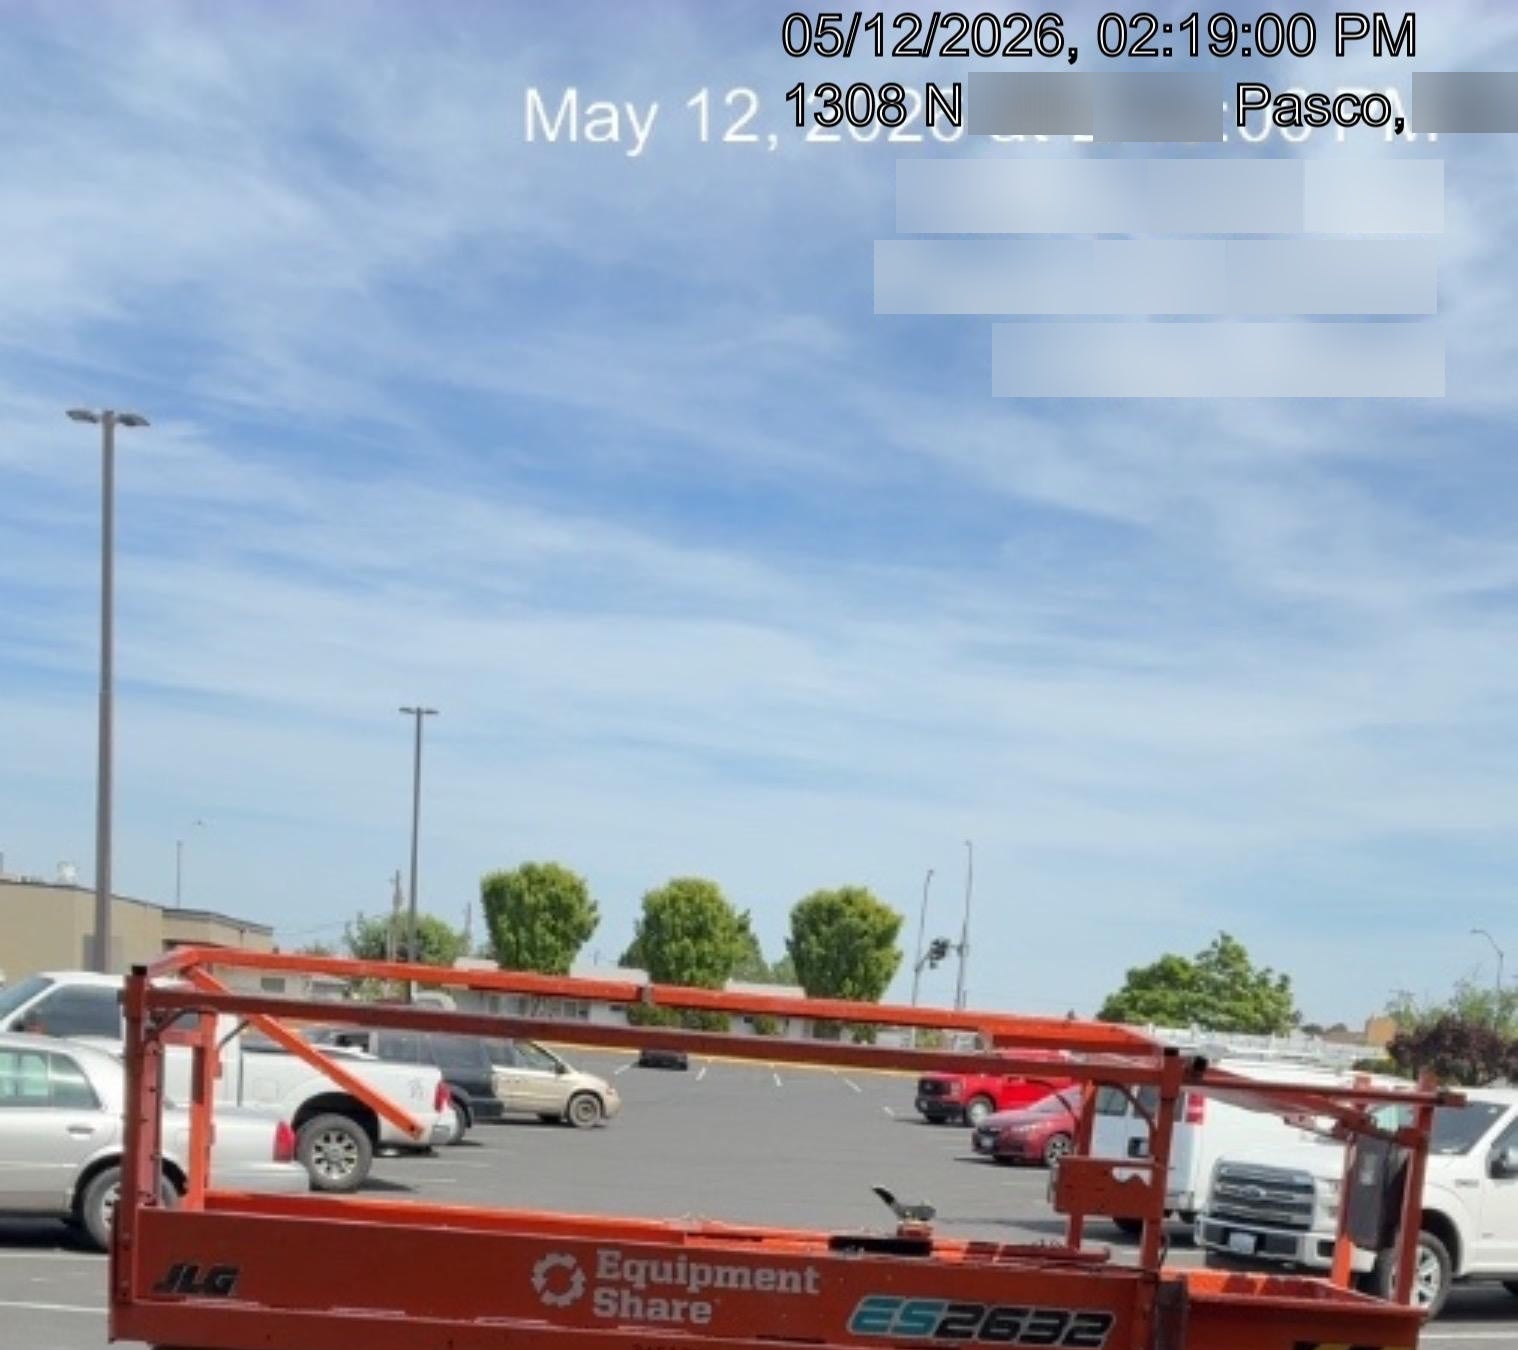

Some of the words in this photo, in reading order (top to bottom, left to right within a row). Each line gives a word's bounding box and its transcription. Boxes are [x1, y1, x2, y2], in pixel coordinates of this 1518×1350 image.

[154, 1263, 240, 1296] JLG
[596, 1249, 820, 1294] Equipment
[593, 1287, 713, 1324] Share
[846, 1295, 1116, 1350] ES2632
